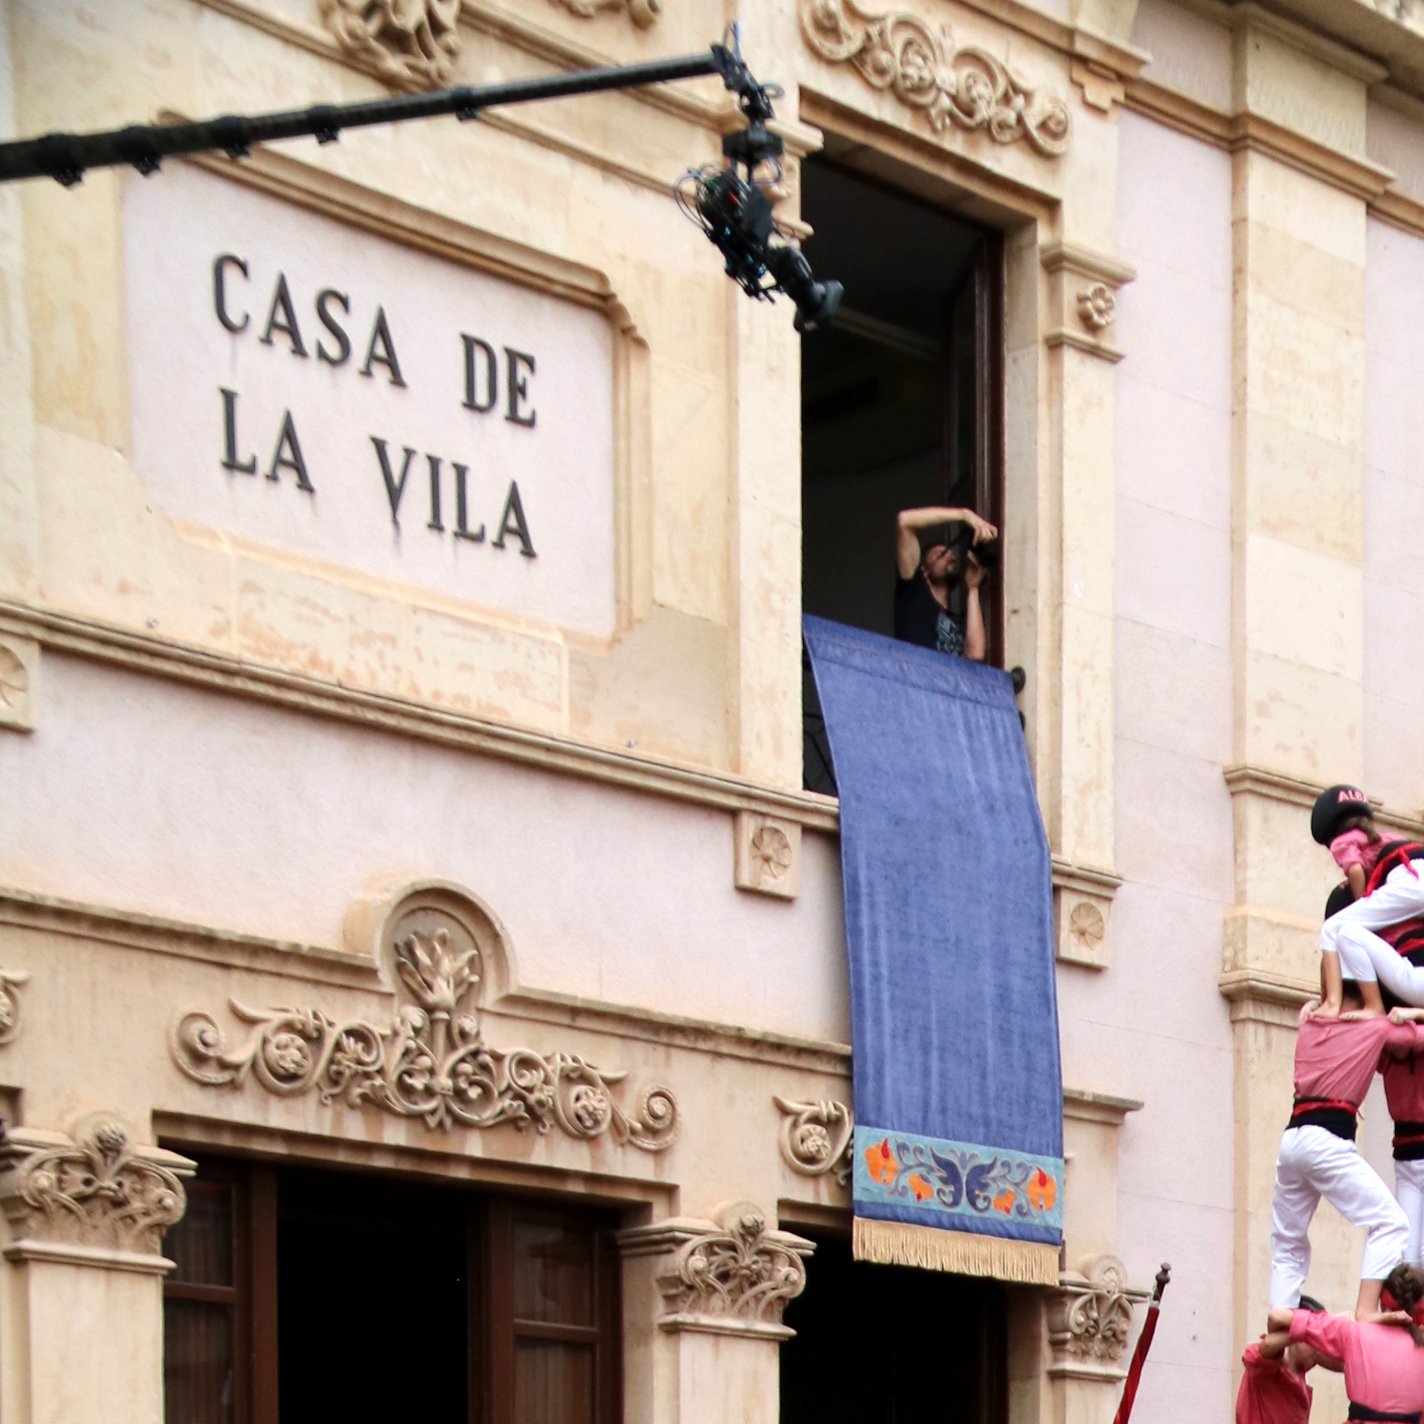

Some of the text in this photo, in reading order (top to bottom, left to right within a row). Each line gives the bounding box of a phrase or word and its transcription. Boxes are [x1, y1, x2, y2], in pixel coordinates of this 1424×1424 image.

[212, 253, 537, 428] CASA DE
[218, 386, 537, 559] LA VILA
